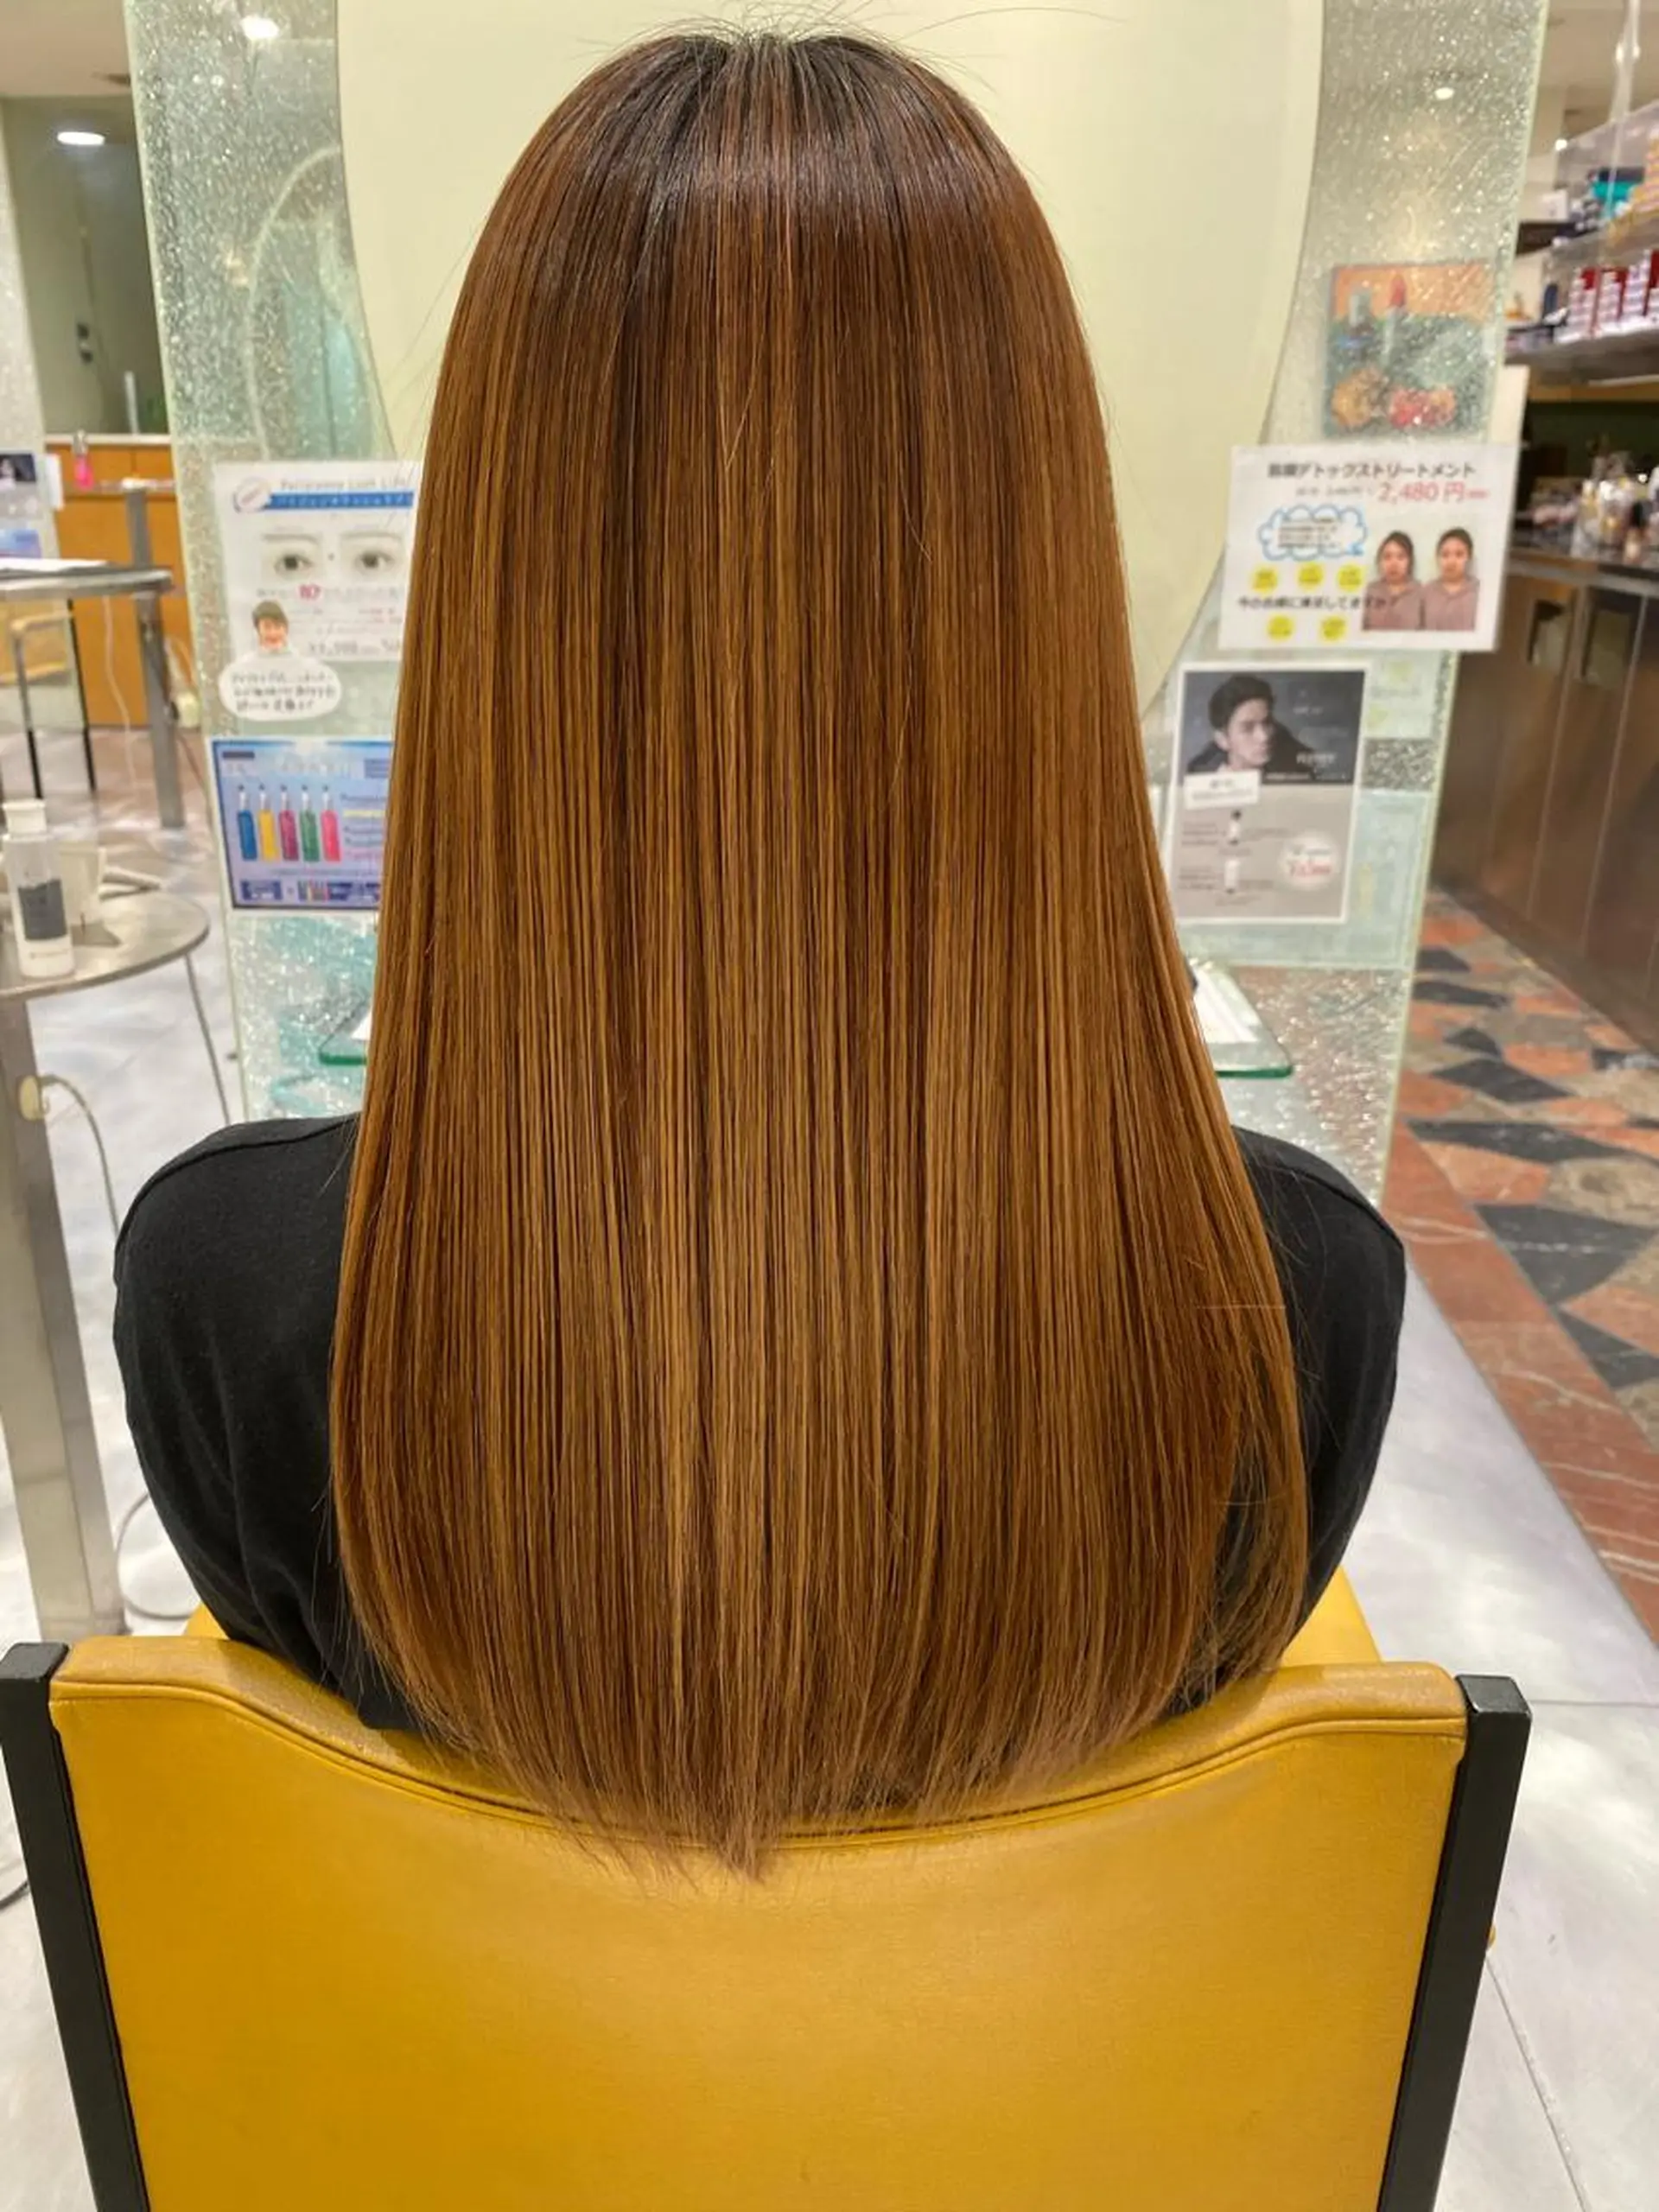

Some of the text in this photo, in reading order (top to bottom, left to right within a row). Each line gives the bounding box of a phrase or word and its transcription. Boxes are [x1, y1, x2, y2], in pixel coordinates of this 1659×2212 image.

[1267, 461, 1476, 480] デトックストリートメント
